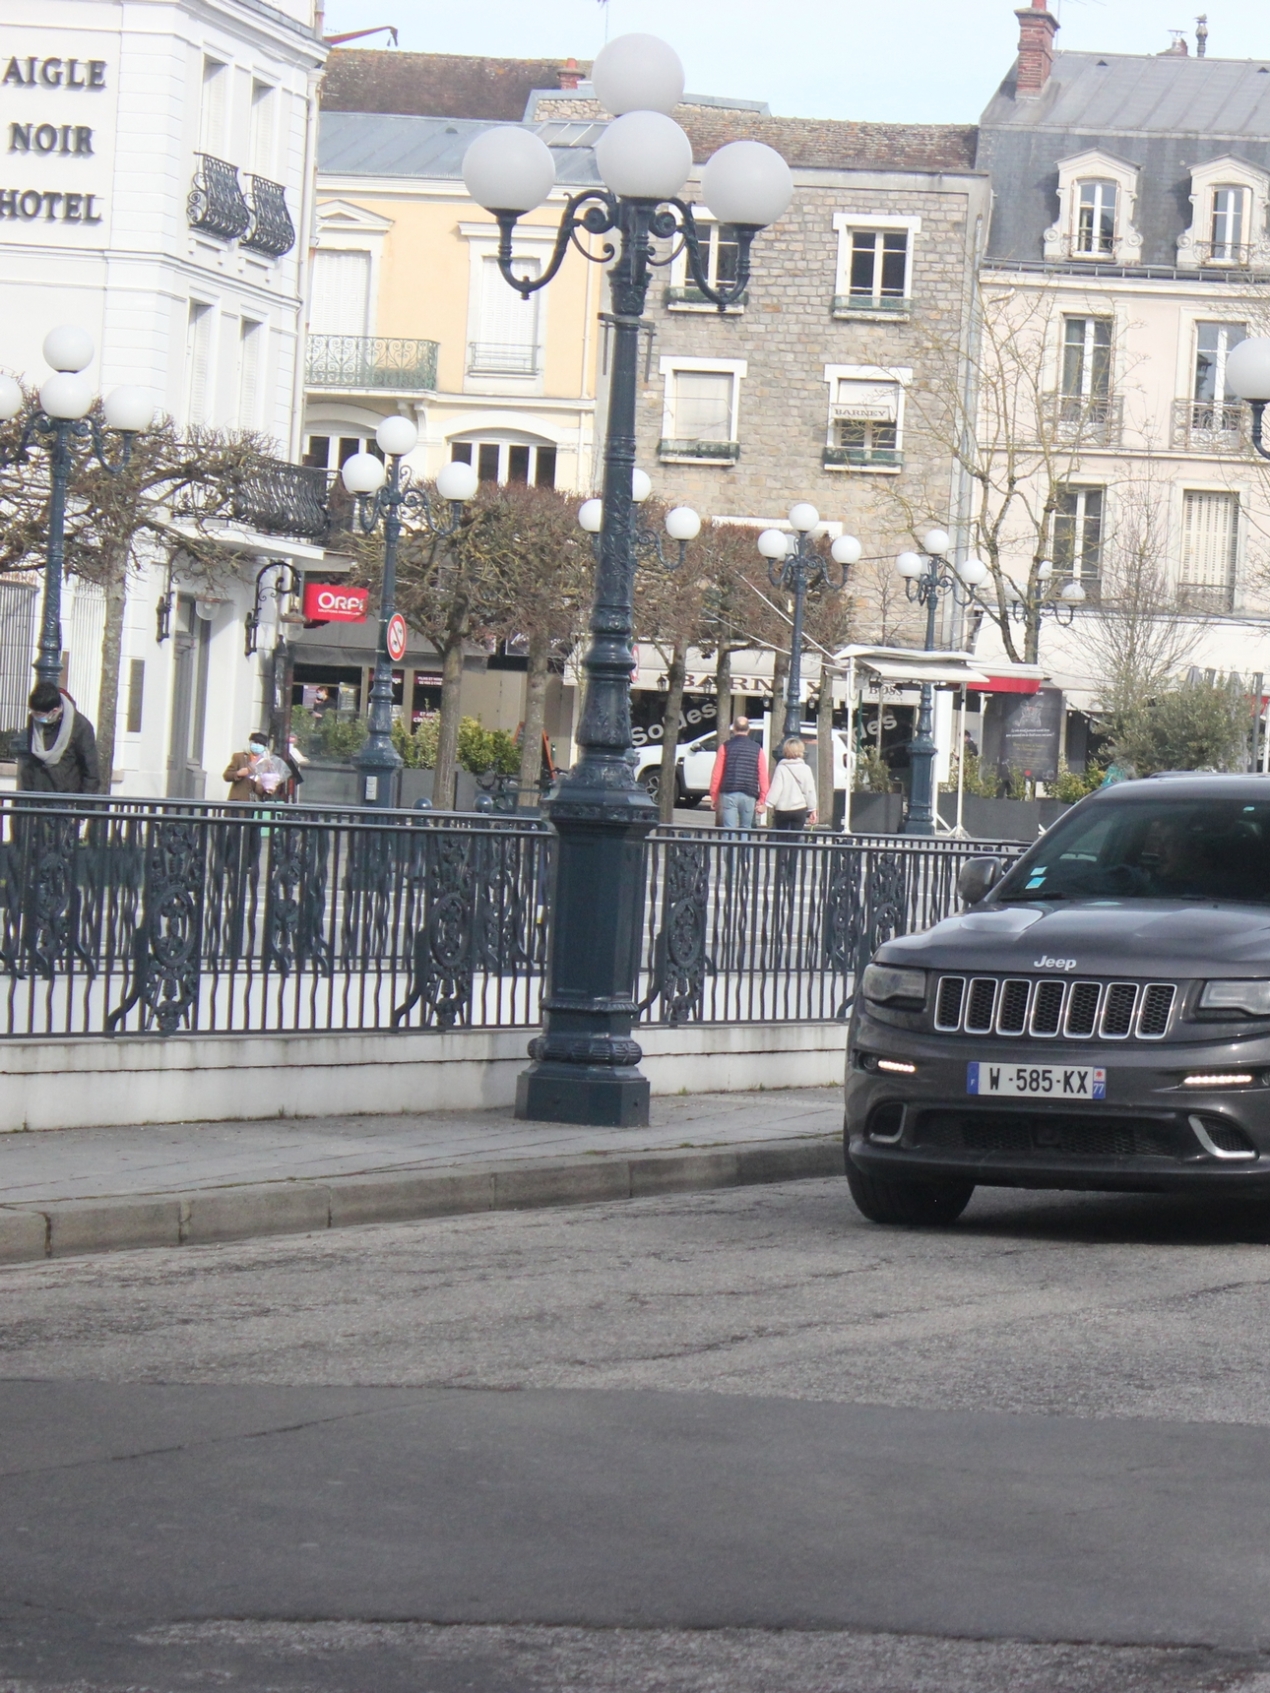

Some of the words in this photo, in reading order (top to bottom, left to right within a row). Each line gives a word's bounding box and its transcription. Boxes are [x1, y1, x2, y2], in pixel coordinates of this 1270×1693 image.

[2, 56, 106, 88] AIGLE
[9, 122, 95, 154] NOIR
[0, 188, 103, 222] HOTEL
[835, 408, 886, 417] BARNEY
[683, 674, 821, 694] BARNY
[630, 703, 717, 746] Sodes
[1034, 955, 1076, 971] Jeep
[1094, 1083, 1104, 1094] 77
